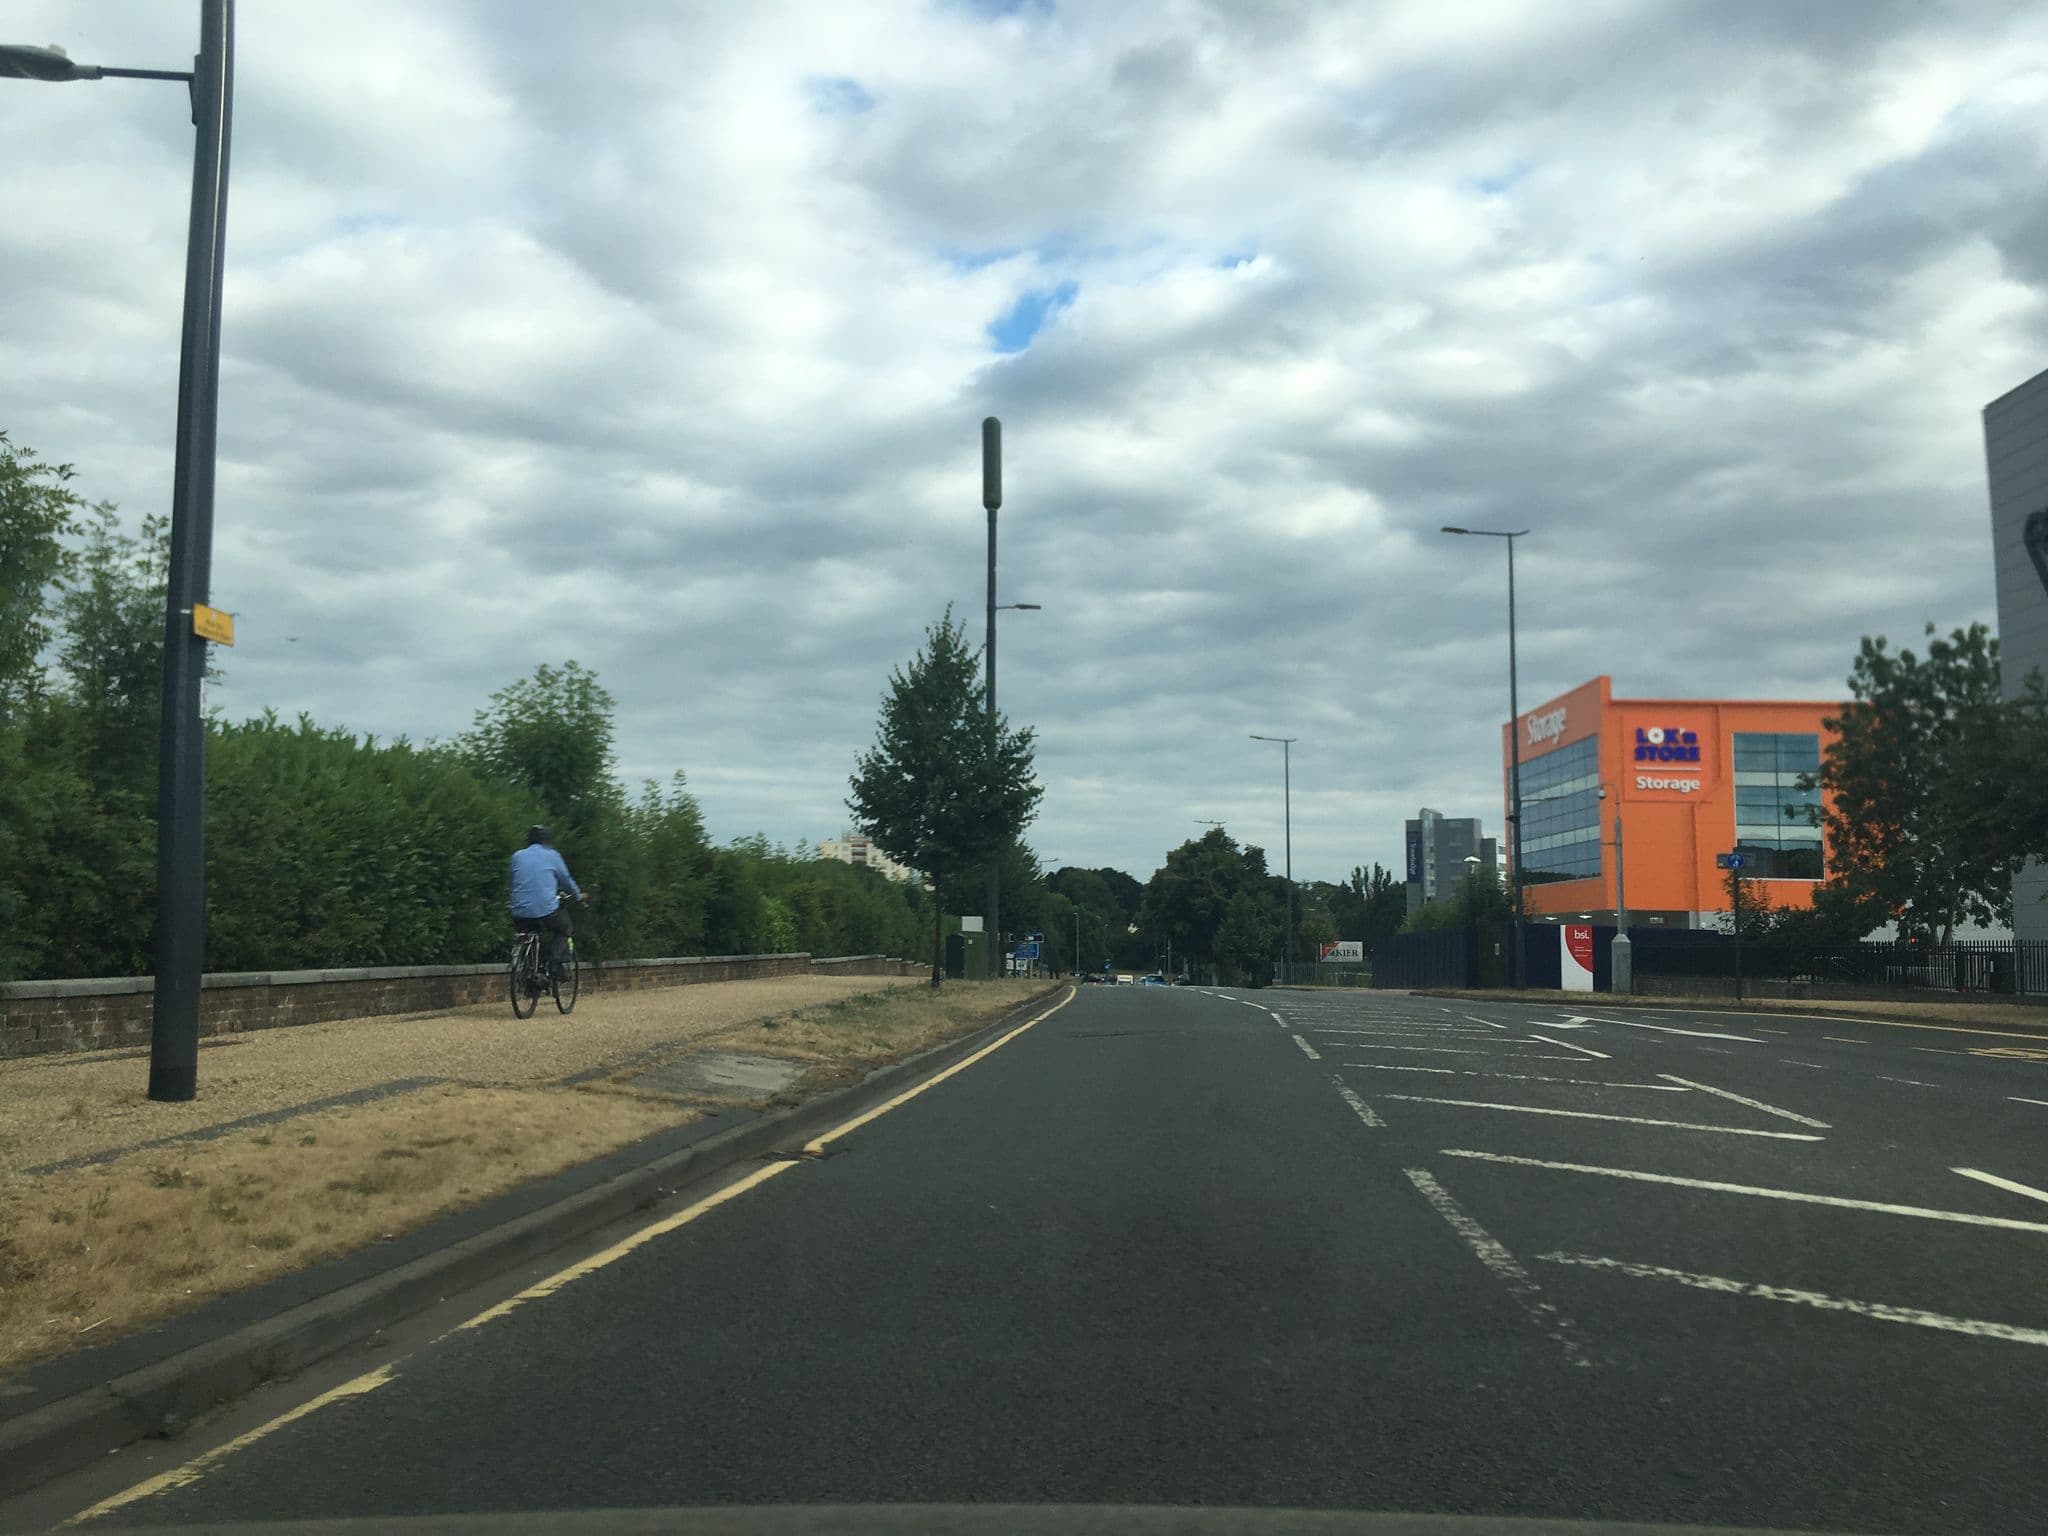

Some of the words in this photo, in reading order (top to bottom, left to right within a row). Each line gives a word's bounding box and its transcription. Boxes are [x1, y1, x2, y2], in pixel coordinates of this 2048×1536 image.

[1527, 707, 1567, 745] Storage
[1635, 745, 1701, 761] STORE
[1636, 775, 1701, 792] Storage
[1335, 949, 1359, 957] KIER
